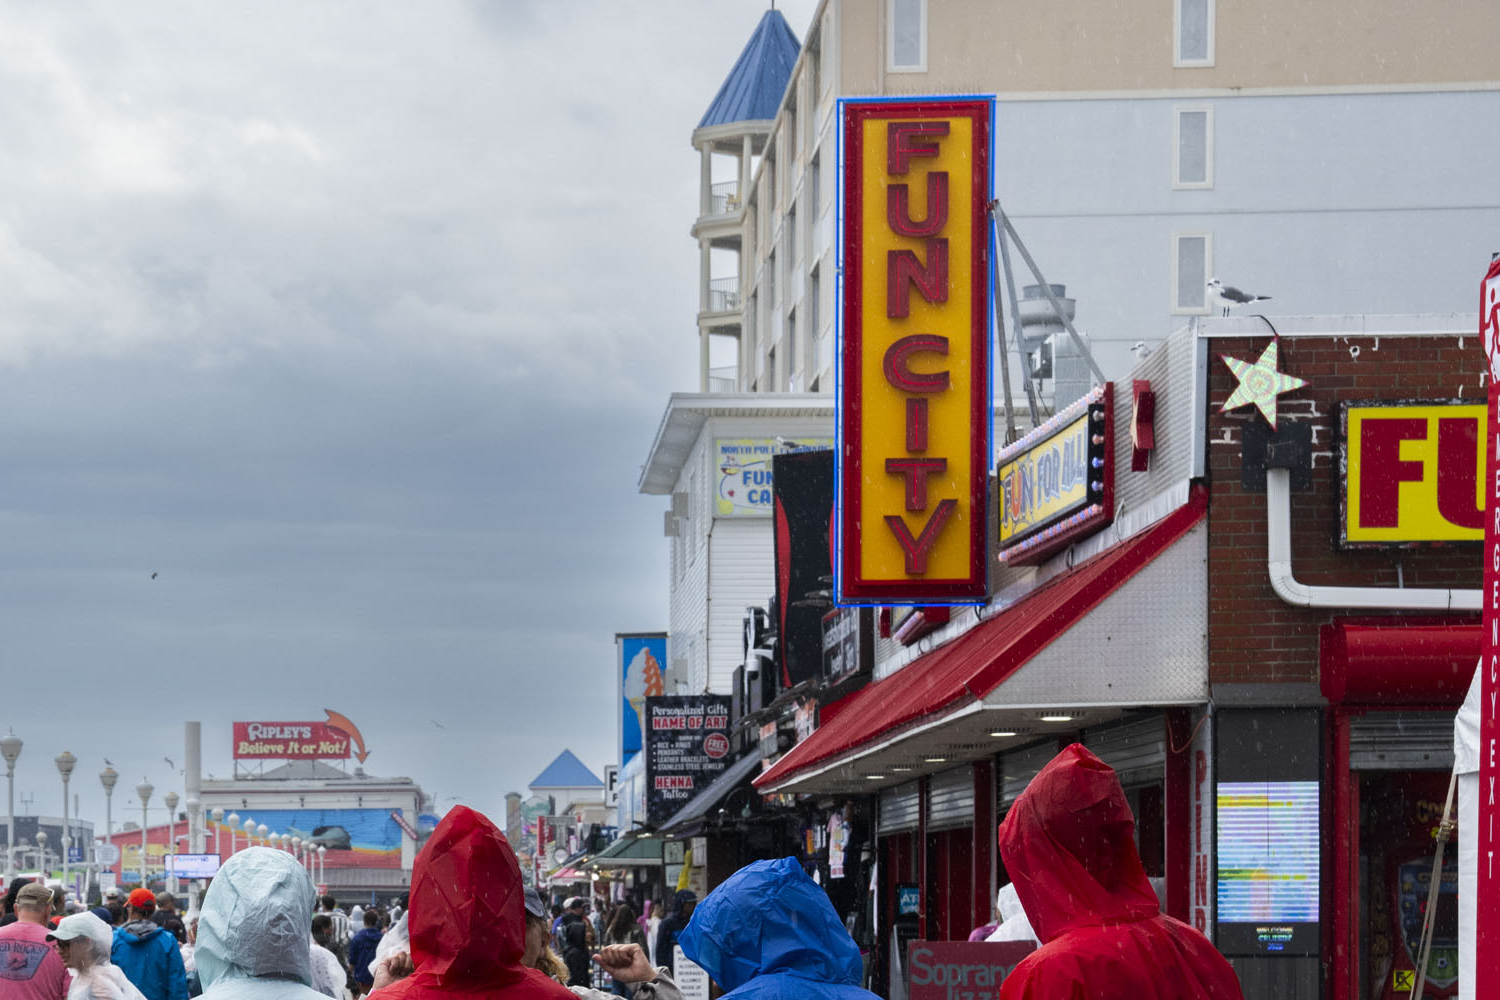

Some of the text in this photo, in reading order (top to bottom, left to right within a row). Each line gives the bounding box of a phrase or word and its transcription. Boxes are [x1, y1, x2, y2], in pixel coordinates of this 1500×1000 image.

[886, 121, 951, 318] FUN
[882, 333, 959, 574] CITY
[1002, 460, 1035, 529] FUN
[1037, 442, 1061, 511] FOR
[652, 715, 728, 730] NAME OF ART
[247, 723, 312, 741] RIPLEY'S
[238, 740, 348, 755] Believe It or Not!
[708, 739, 725, 750] FREE
[654, 775, 694, 790] HENNA
[661, 789, 689, 799] Tattoo
[1487, 738, 1496, 880] EXIT
[900, 892, 920, 906] AT
